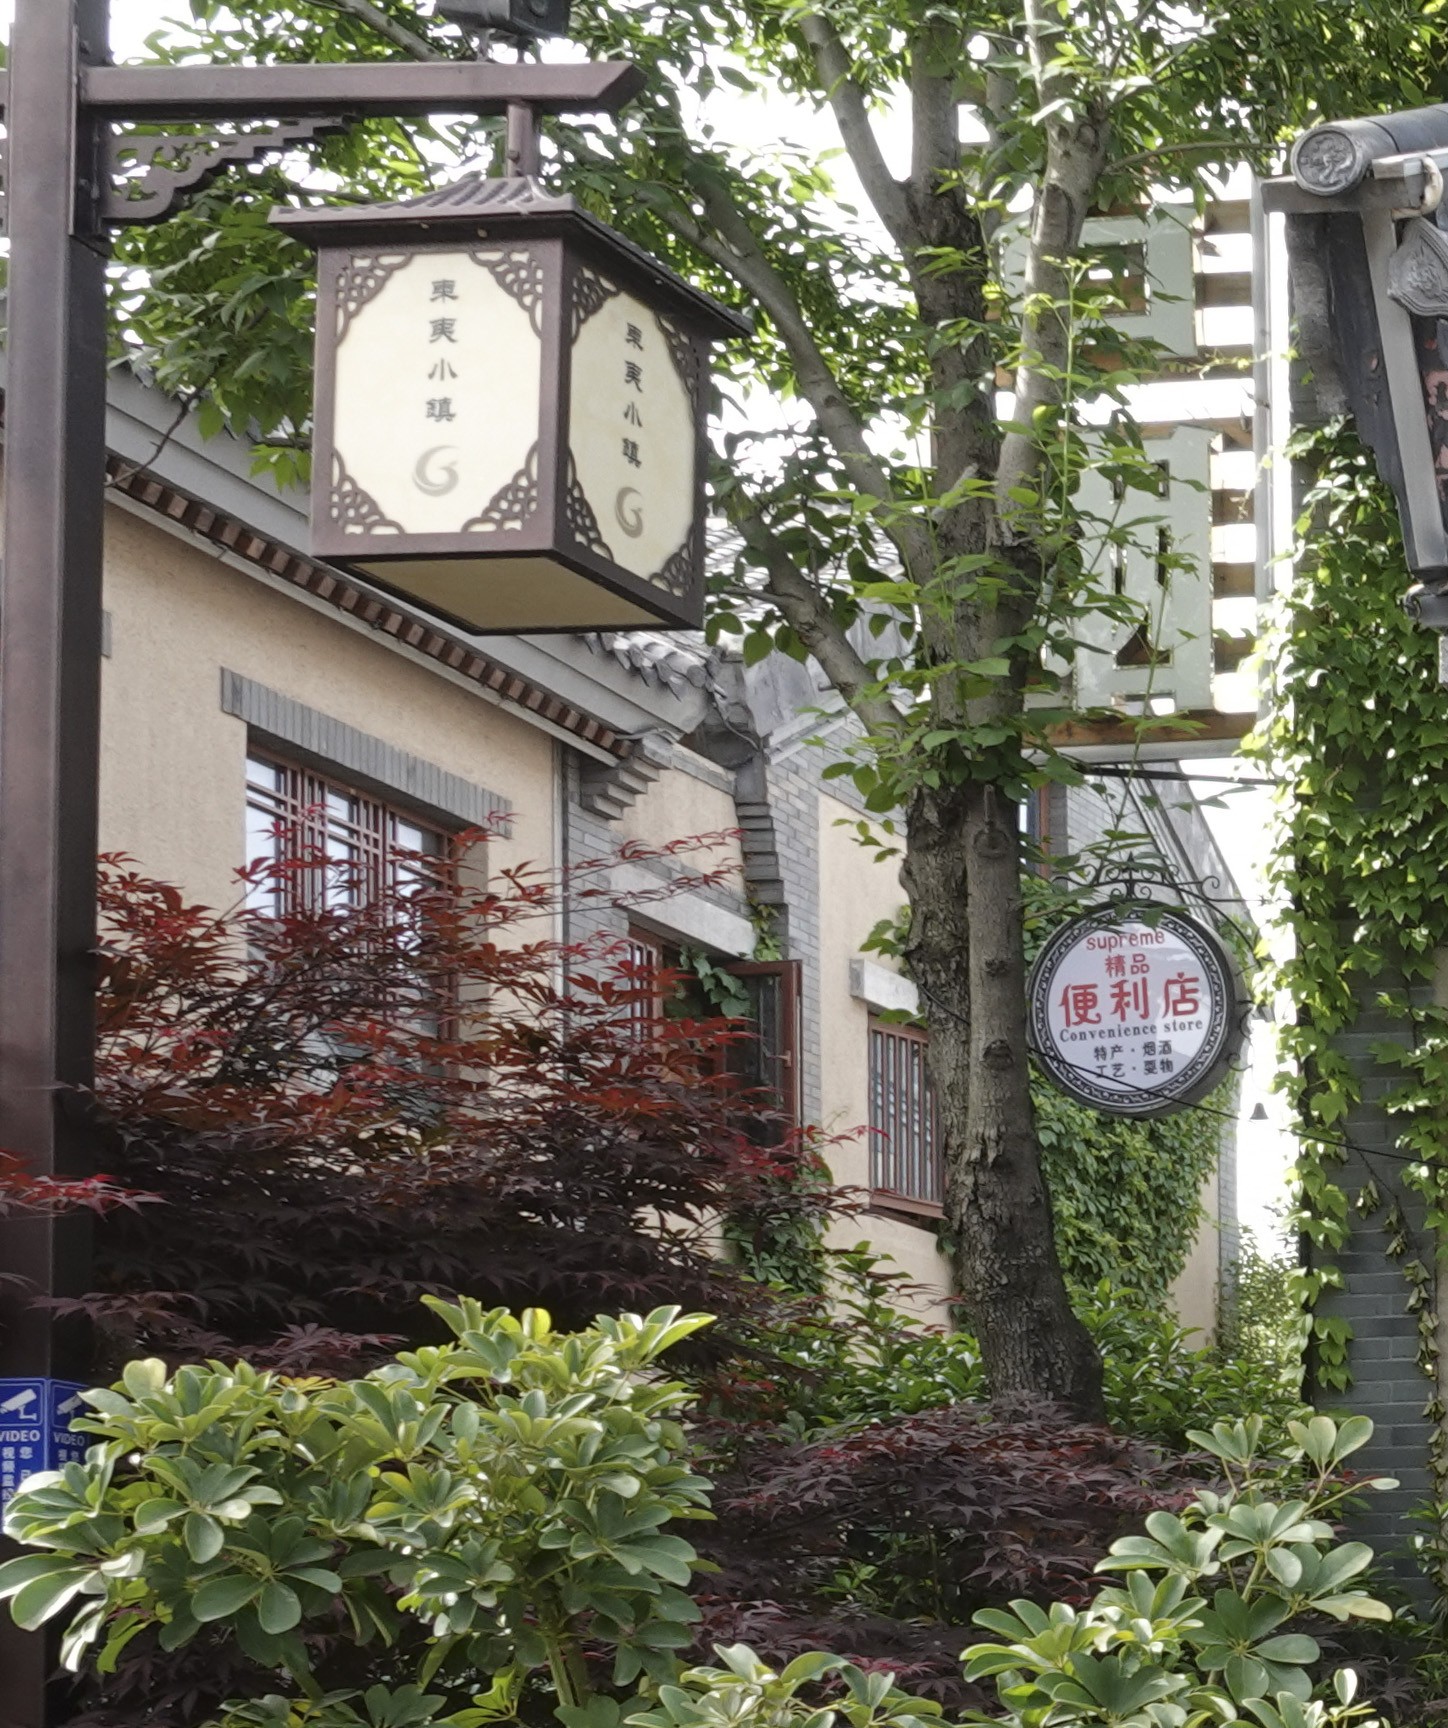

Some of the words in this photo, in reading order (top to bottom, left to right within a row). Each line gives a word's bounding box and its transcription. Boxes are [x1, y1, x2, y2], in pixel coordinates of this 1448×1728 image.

[1086, 930, 1165, 953] supreme
[1104, 952, 1150, 978] 精品
[1058, 971, 1200, 1028] 便利店
[1060, 1023, 1157, 1042] Convenience
[1163, 1019, 1203, 1032] store
